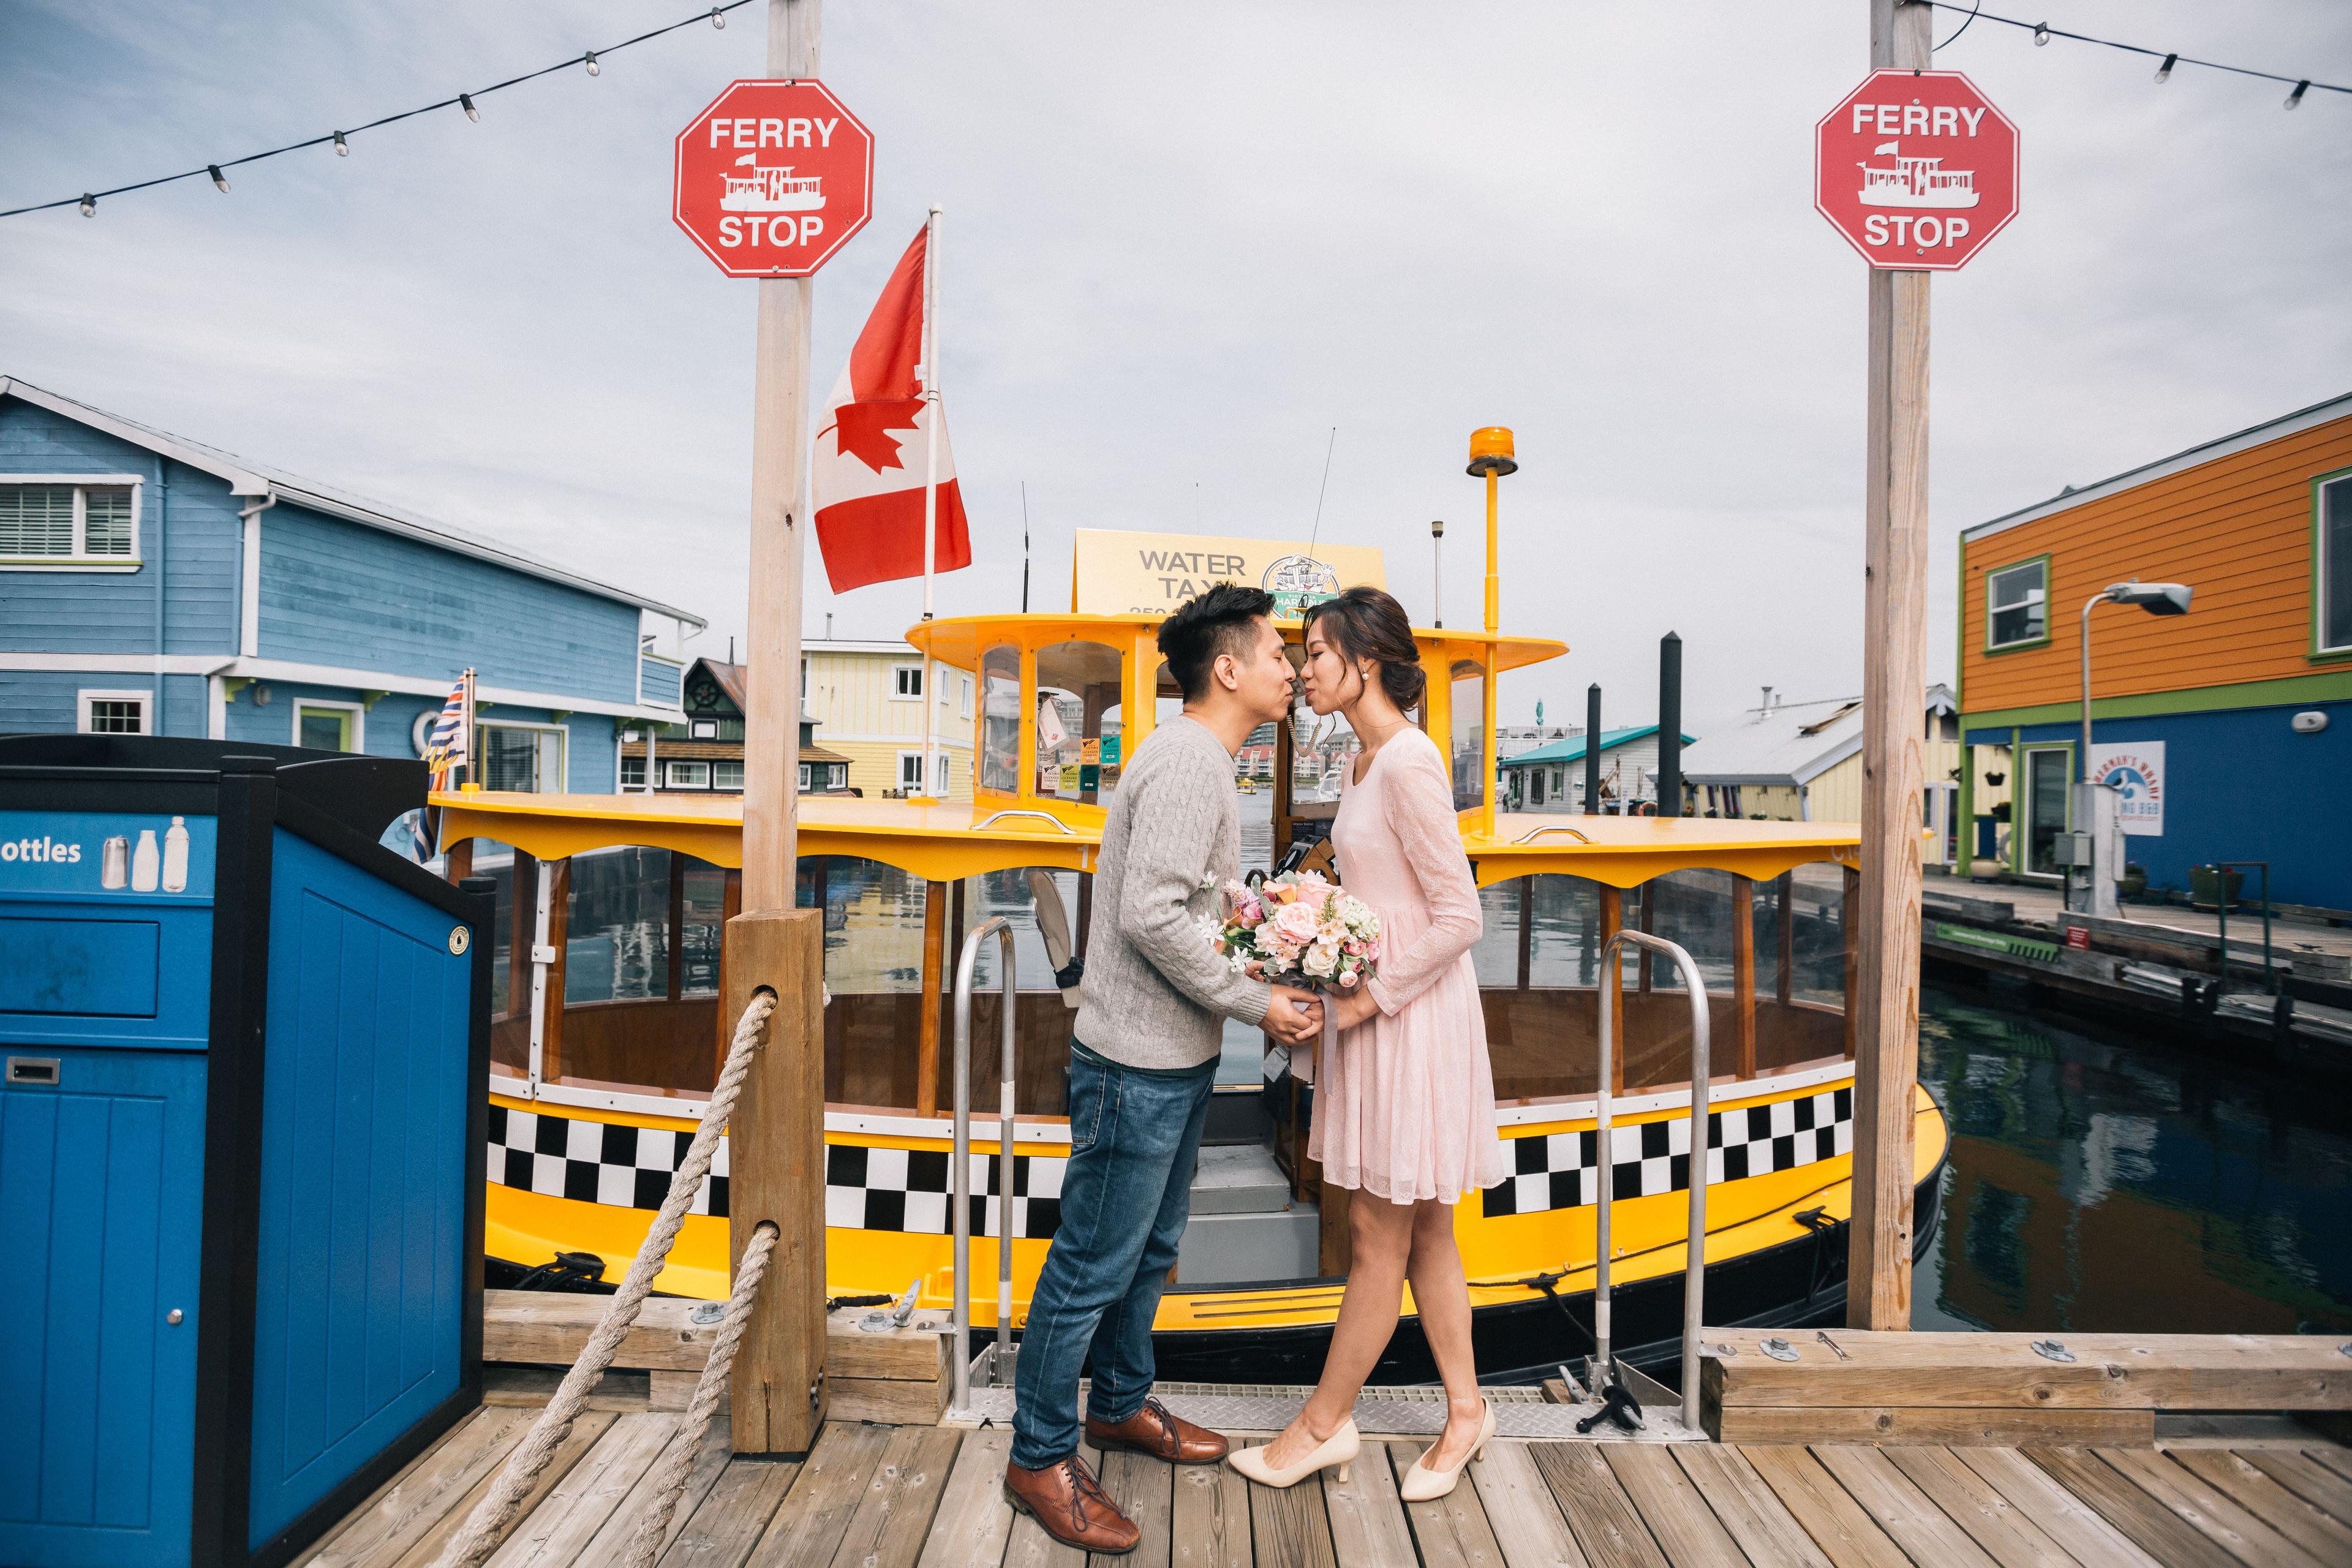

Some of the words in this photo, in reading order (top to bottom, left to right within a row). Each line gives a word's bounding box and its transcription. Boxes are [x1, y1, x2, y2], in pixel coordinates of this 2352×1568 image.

[710, 118, 839, 148] FERRY
[1853, 104, 1986, 137] FERRY
[718, 216, 824, 247] STOP
[1864, 214, 1970, 247] STOP
[1139, 550, 1246, 576] WATER
